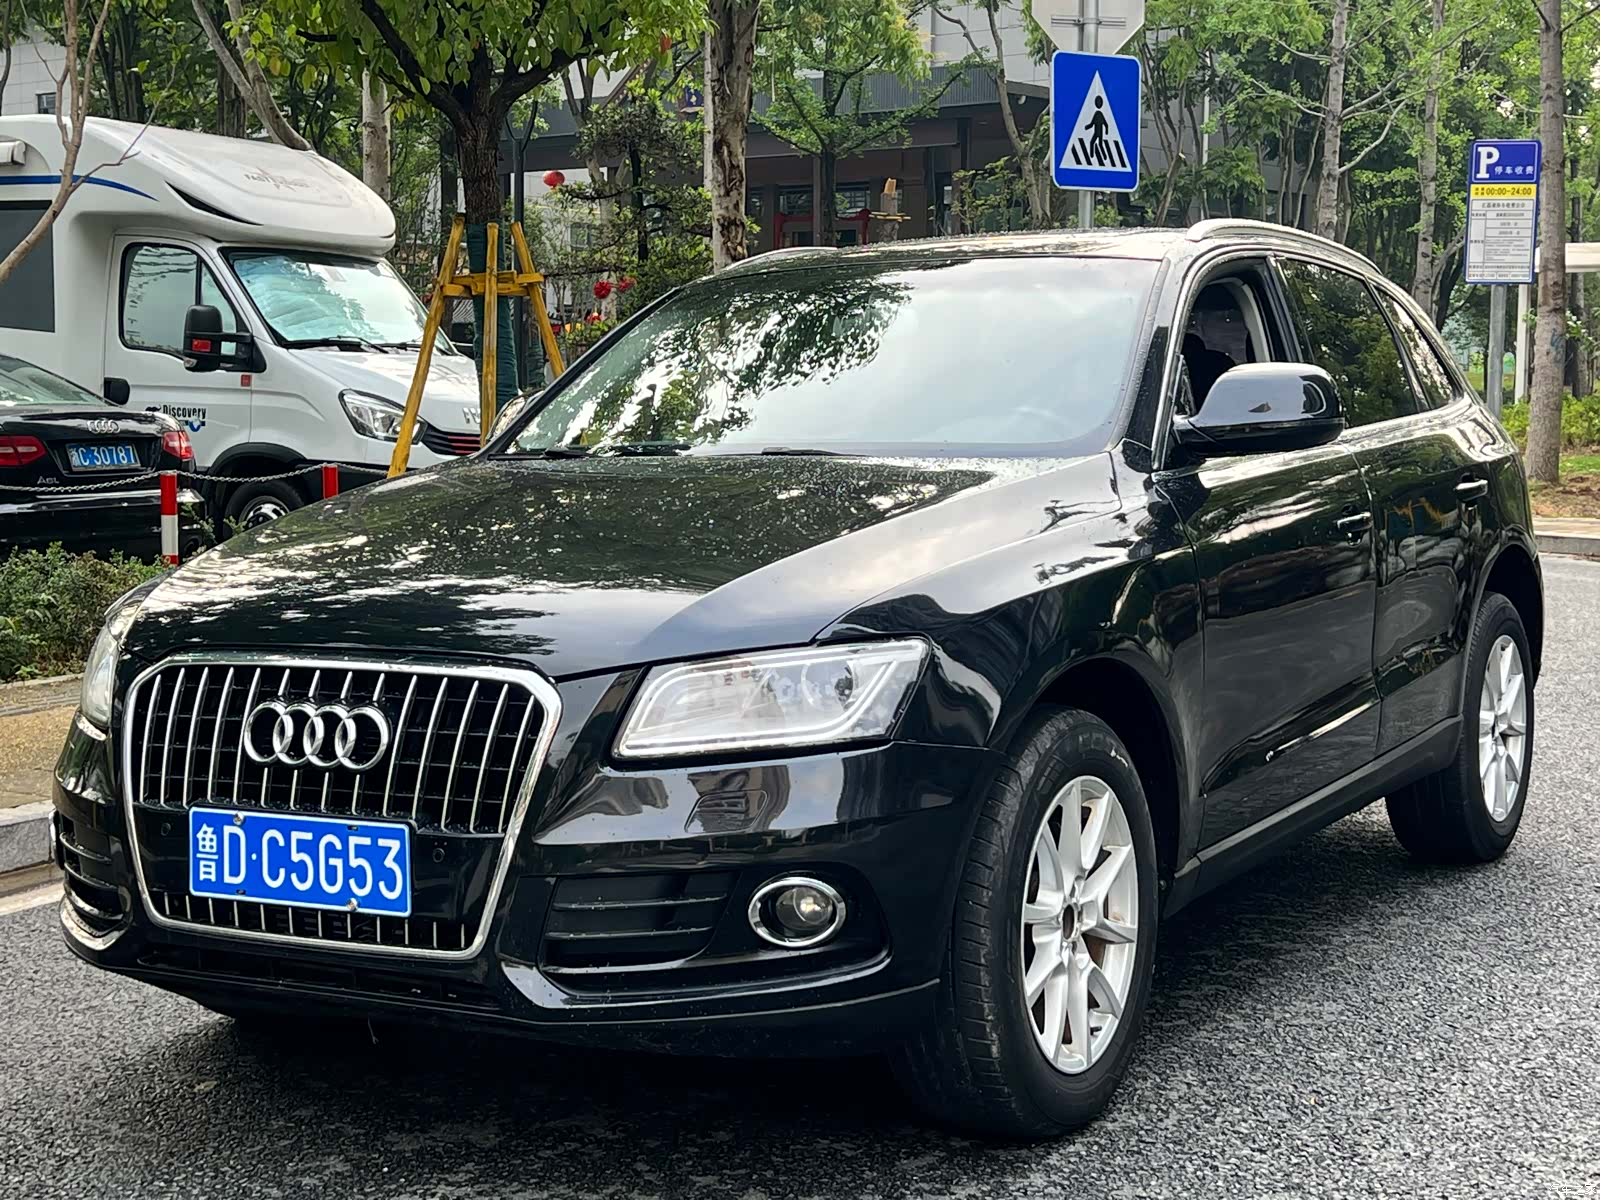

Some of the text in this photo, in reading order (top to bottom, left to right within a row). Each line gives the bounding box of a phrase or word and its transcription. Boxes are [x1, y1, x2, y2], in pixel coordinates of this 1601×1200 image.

[1476, 146, 1500, 179] P
[1494, 165, 1534, 175] 停车收费
[1486, 187, 1532, 196] 00:00-24:00
[163, 404, 207, 419] Discovery
